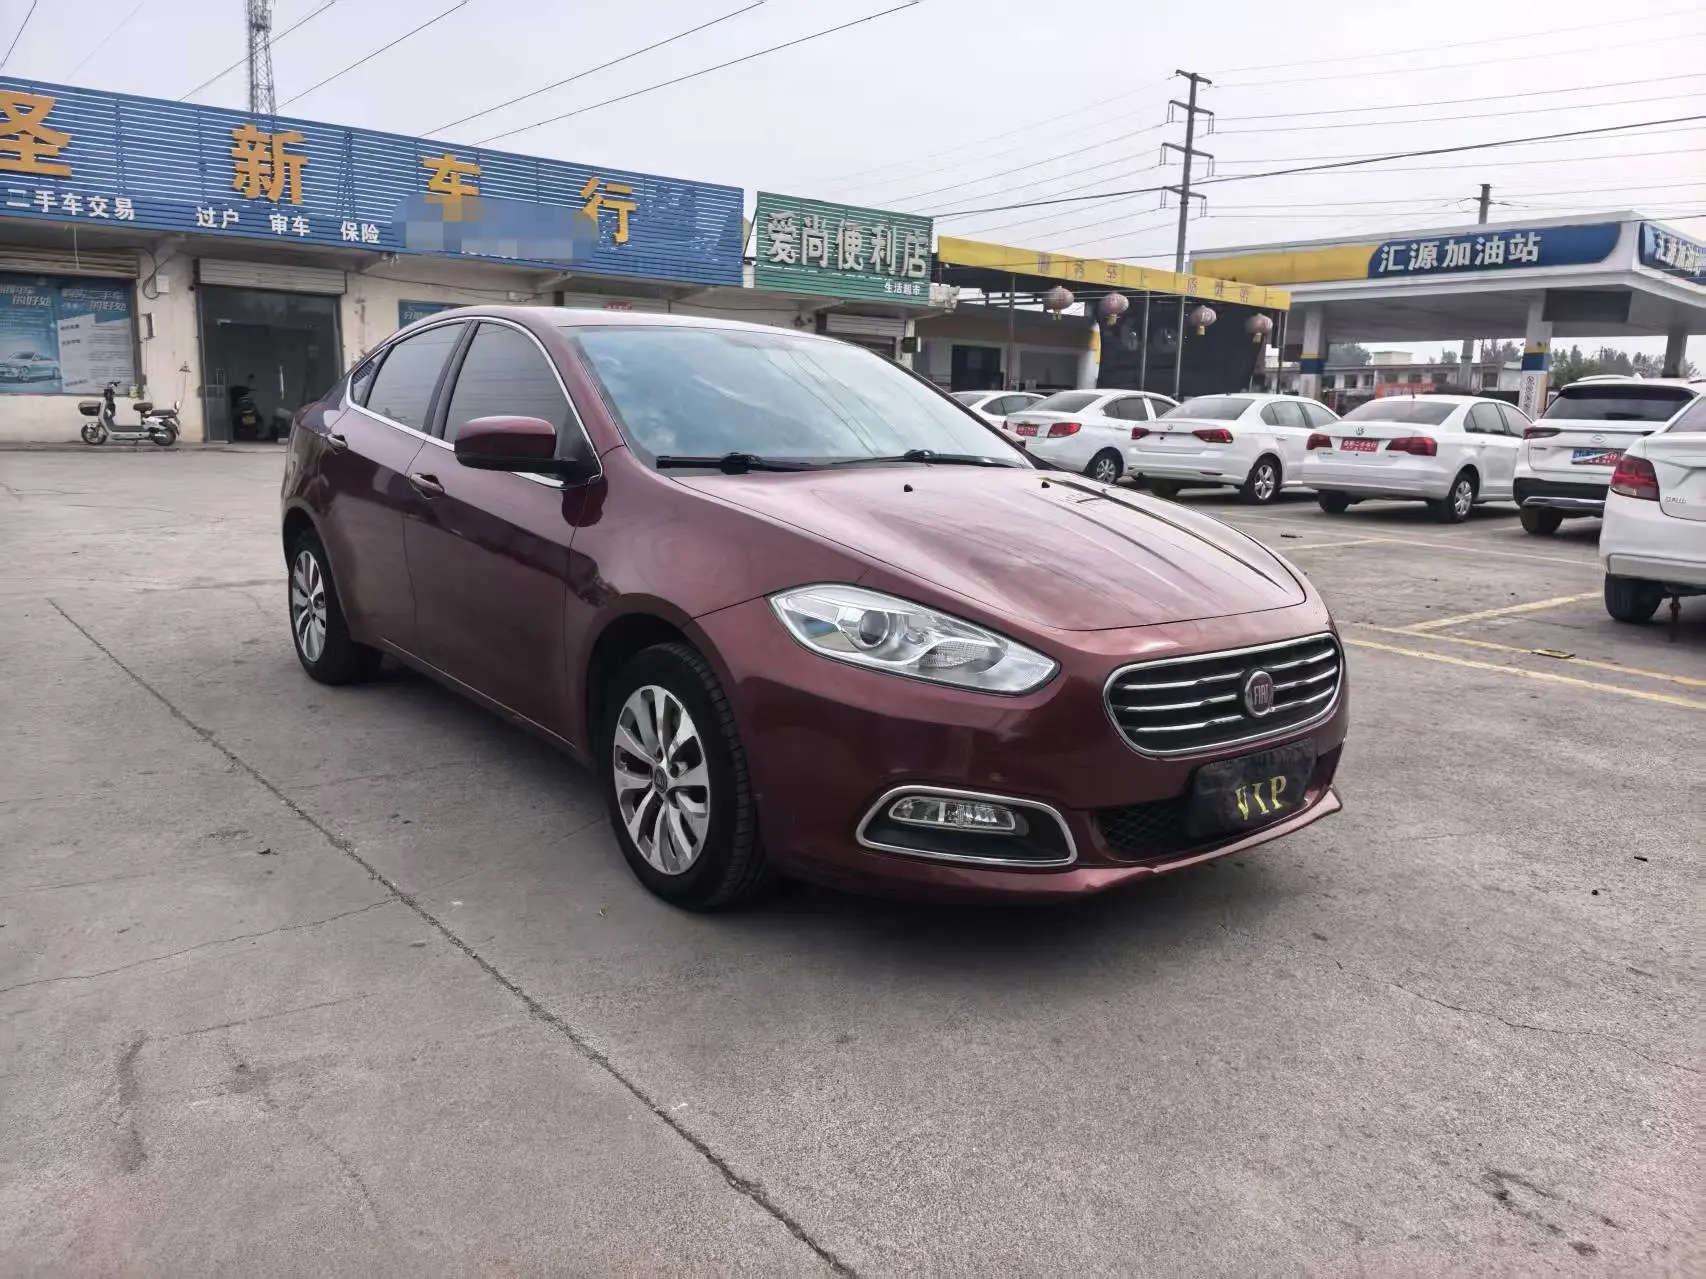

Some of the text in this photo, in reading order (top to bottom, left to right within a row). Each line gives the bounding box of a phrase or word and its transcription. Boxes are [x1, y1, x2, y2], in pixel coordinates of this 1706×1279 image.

[6, 188, 135, 220] 二手车交易
[196, 206, 240, 229] 过户
[269, 213, 311, 236] 审车
[340, 220, 381, 243] 保险
[767, 211, 929, 279] 爱尚便利店
[1378, 231, 1543, 273] 汇源加油站
[1253, 683, 1270, 705] FIAT
[1234, 775, 1287, 820] VIP
